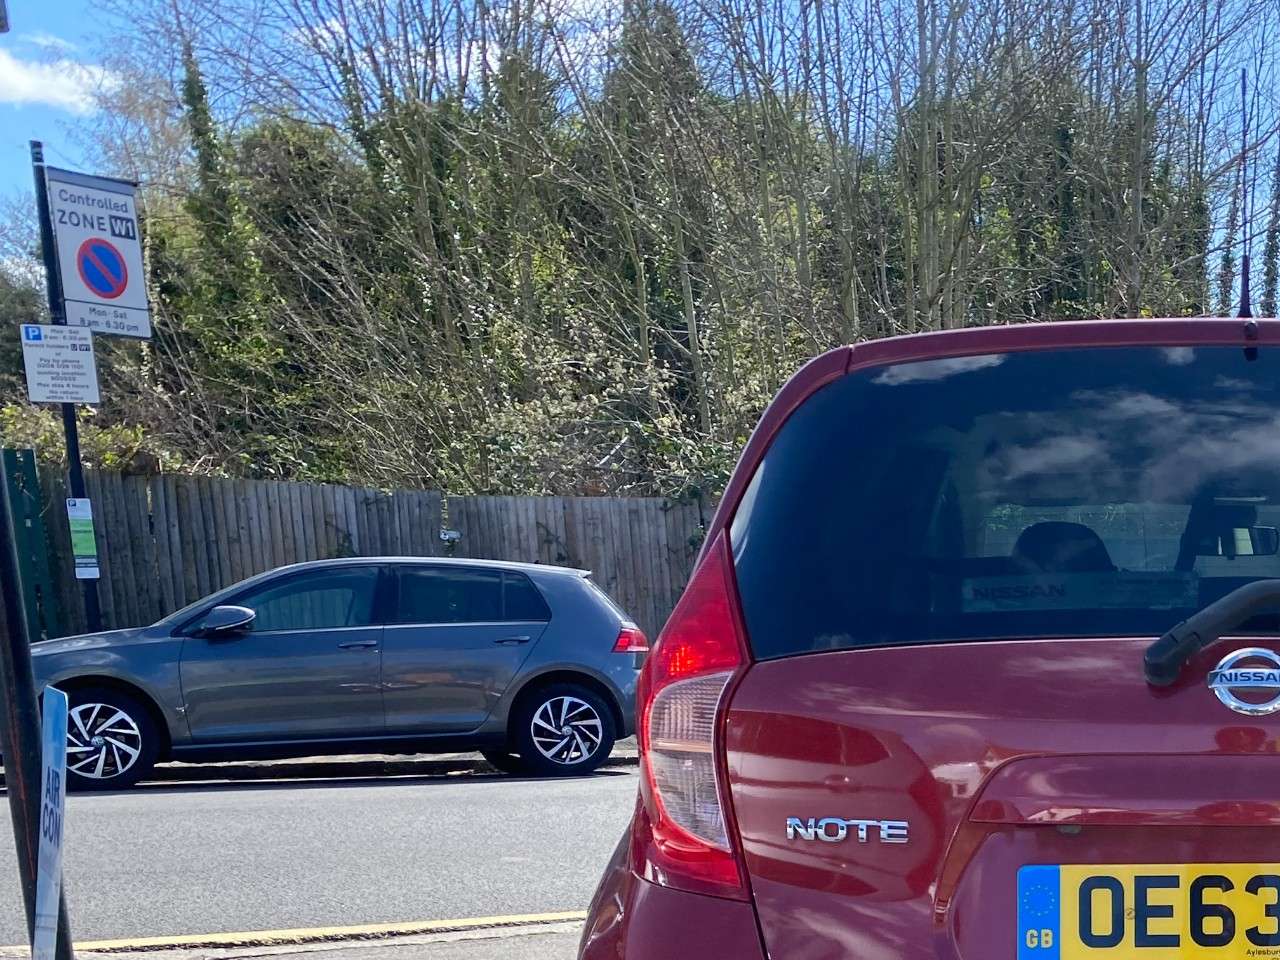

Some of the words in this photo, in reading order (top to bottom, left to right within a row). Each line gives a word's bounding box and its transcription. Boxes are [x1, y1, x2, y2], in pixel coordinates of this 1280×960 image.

[58, 188, 129, 213] Controlled
[57, 208, 107, 231] ZONE
[110, 216, 134, 238] W1
[89, 306, 106, 316] Mon
[113, 310, 127, 319] Sat
[972, 583, 1066, 600] NISSAN
[45, 766, 60, 809] AIR
[42, 802, 61, 848] CON
[786, 817, 909, 844] NOTE
[1026, 929, 1053, 948] GB
